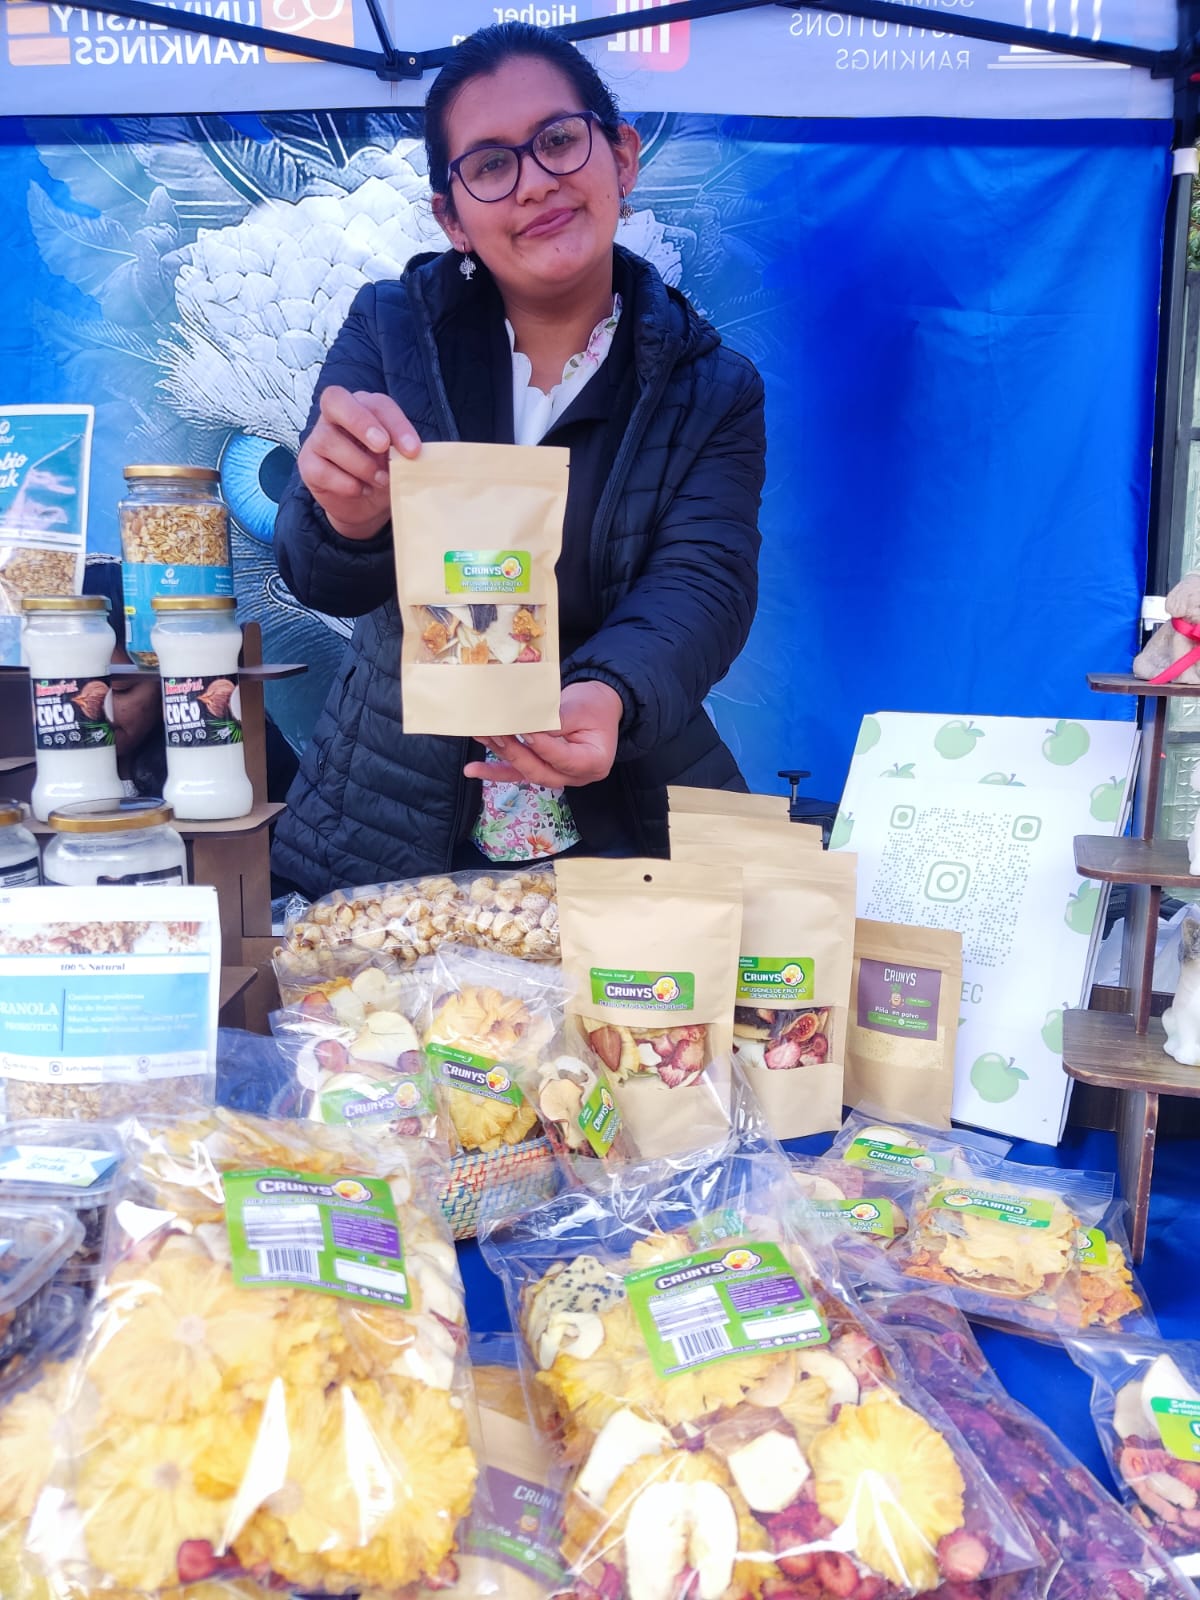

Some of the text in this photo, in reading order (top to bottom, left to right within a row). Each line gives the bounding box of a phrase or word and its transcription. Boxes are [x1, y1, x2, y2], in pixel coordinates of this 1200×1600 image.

[37, 703, 75, 727] COCO
[166, 700, 201, 725] COCO
[89, 962, 126, 971] Natural
[742, 972, 781, 983] CRUNYS
[883, 968, 917, 986] CRUNYS
[606, 985, 653, 999] CRUNYS
[443, 1063, 486, 1084] CRUNYS
[345, 1098, 396, 1117] CRUNYS
[869, 1150, 911, 1165] CRUNYS
[259, 1180, 334, 1196] CRUNYS
[972, 1198, 1025, 1214] CRUNYS
[658, 1262, 725, 1290] CRUNYS
